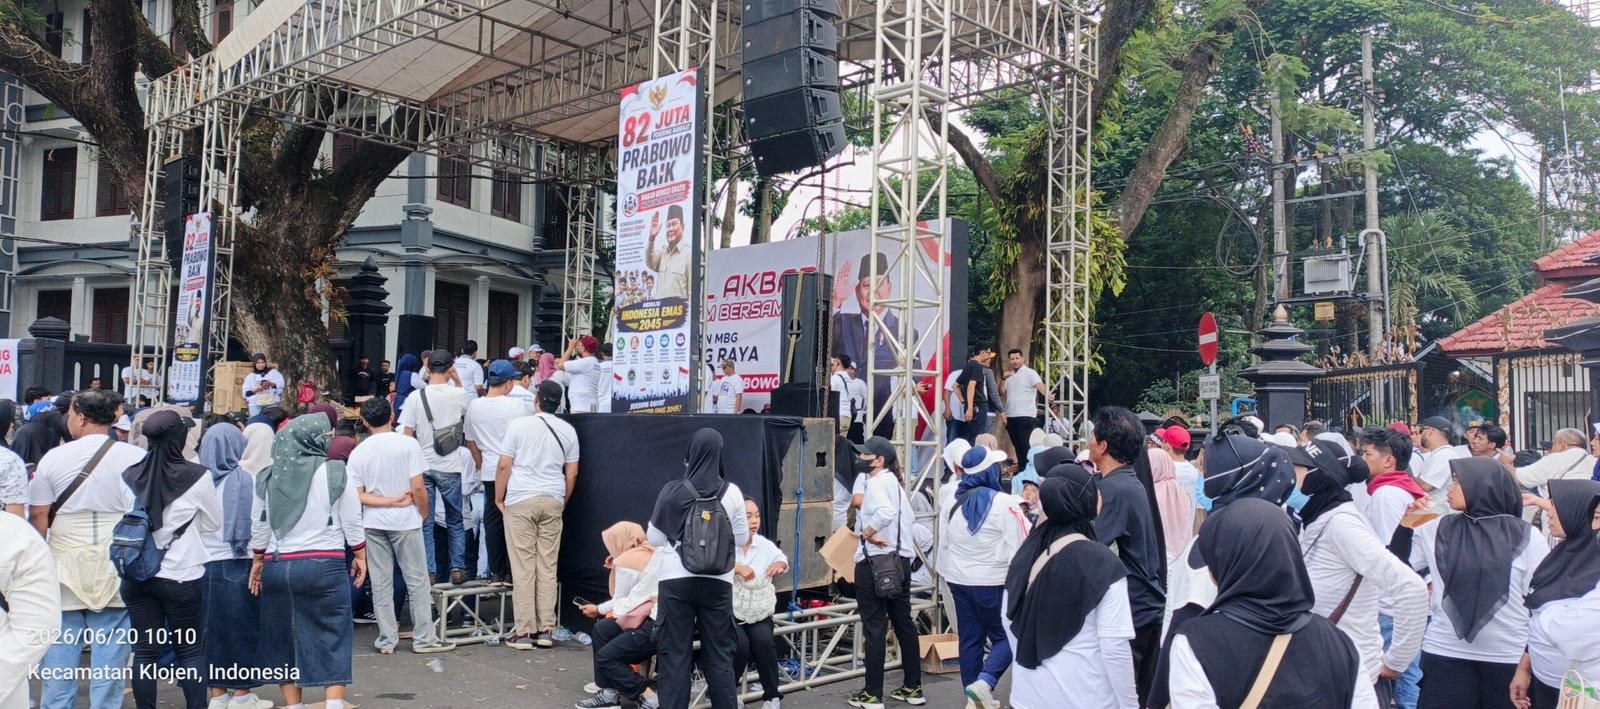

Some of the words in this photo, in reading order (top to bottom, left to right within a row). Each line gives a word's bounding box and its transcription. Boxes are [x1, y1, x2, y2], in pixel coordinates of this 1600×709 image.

[622, 112, 651, 148] 82
[655, 104, 690, 129] JUTA
[622, 133, 692, 171] PRABOWO
[637, 160, 676, 190] BAIK
[185, 232, 195, 251] 82
[187, 263, 202, 278] BAIK
[723, 266, 817, 298] AKBA
[621, 307, 660, 321] INDONESIA
[661, 305, 684, 317] EMAS
[718, 299, 783, 322] BERSAM
[639, 318, 661, 331] 2045
[714, 332, 738, 344] MBG
[717, 346, 759, 363] RAYA
